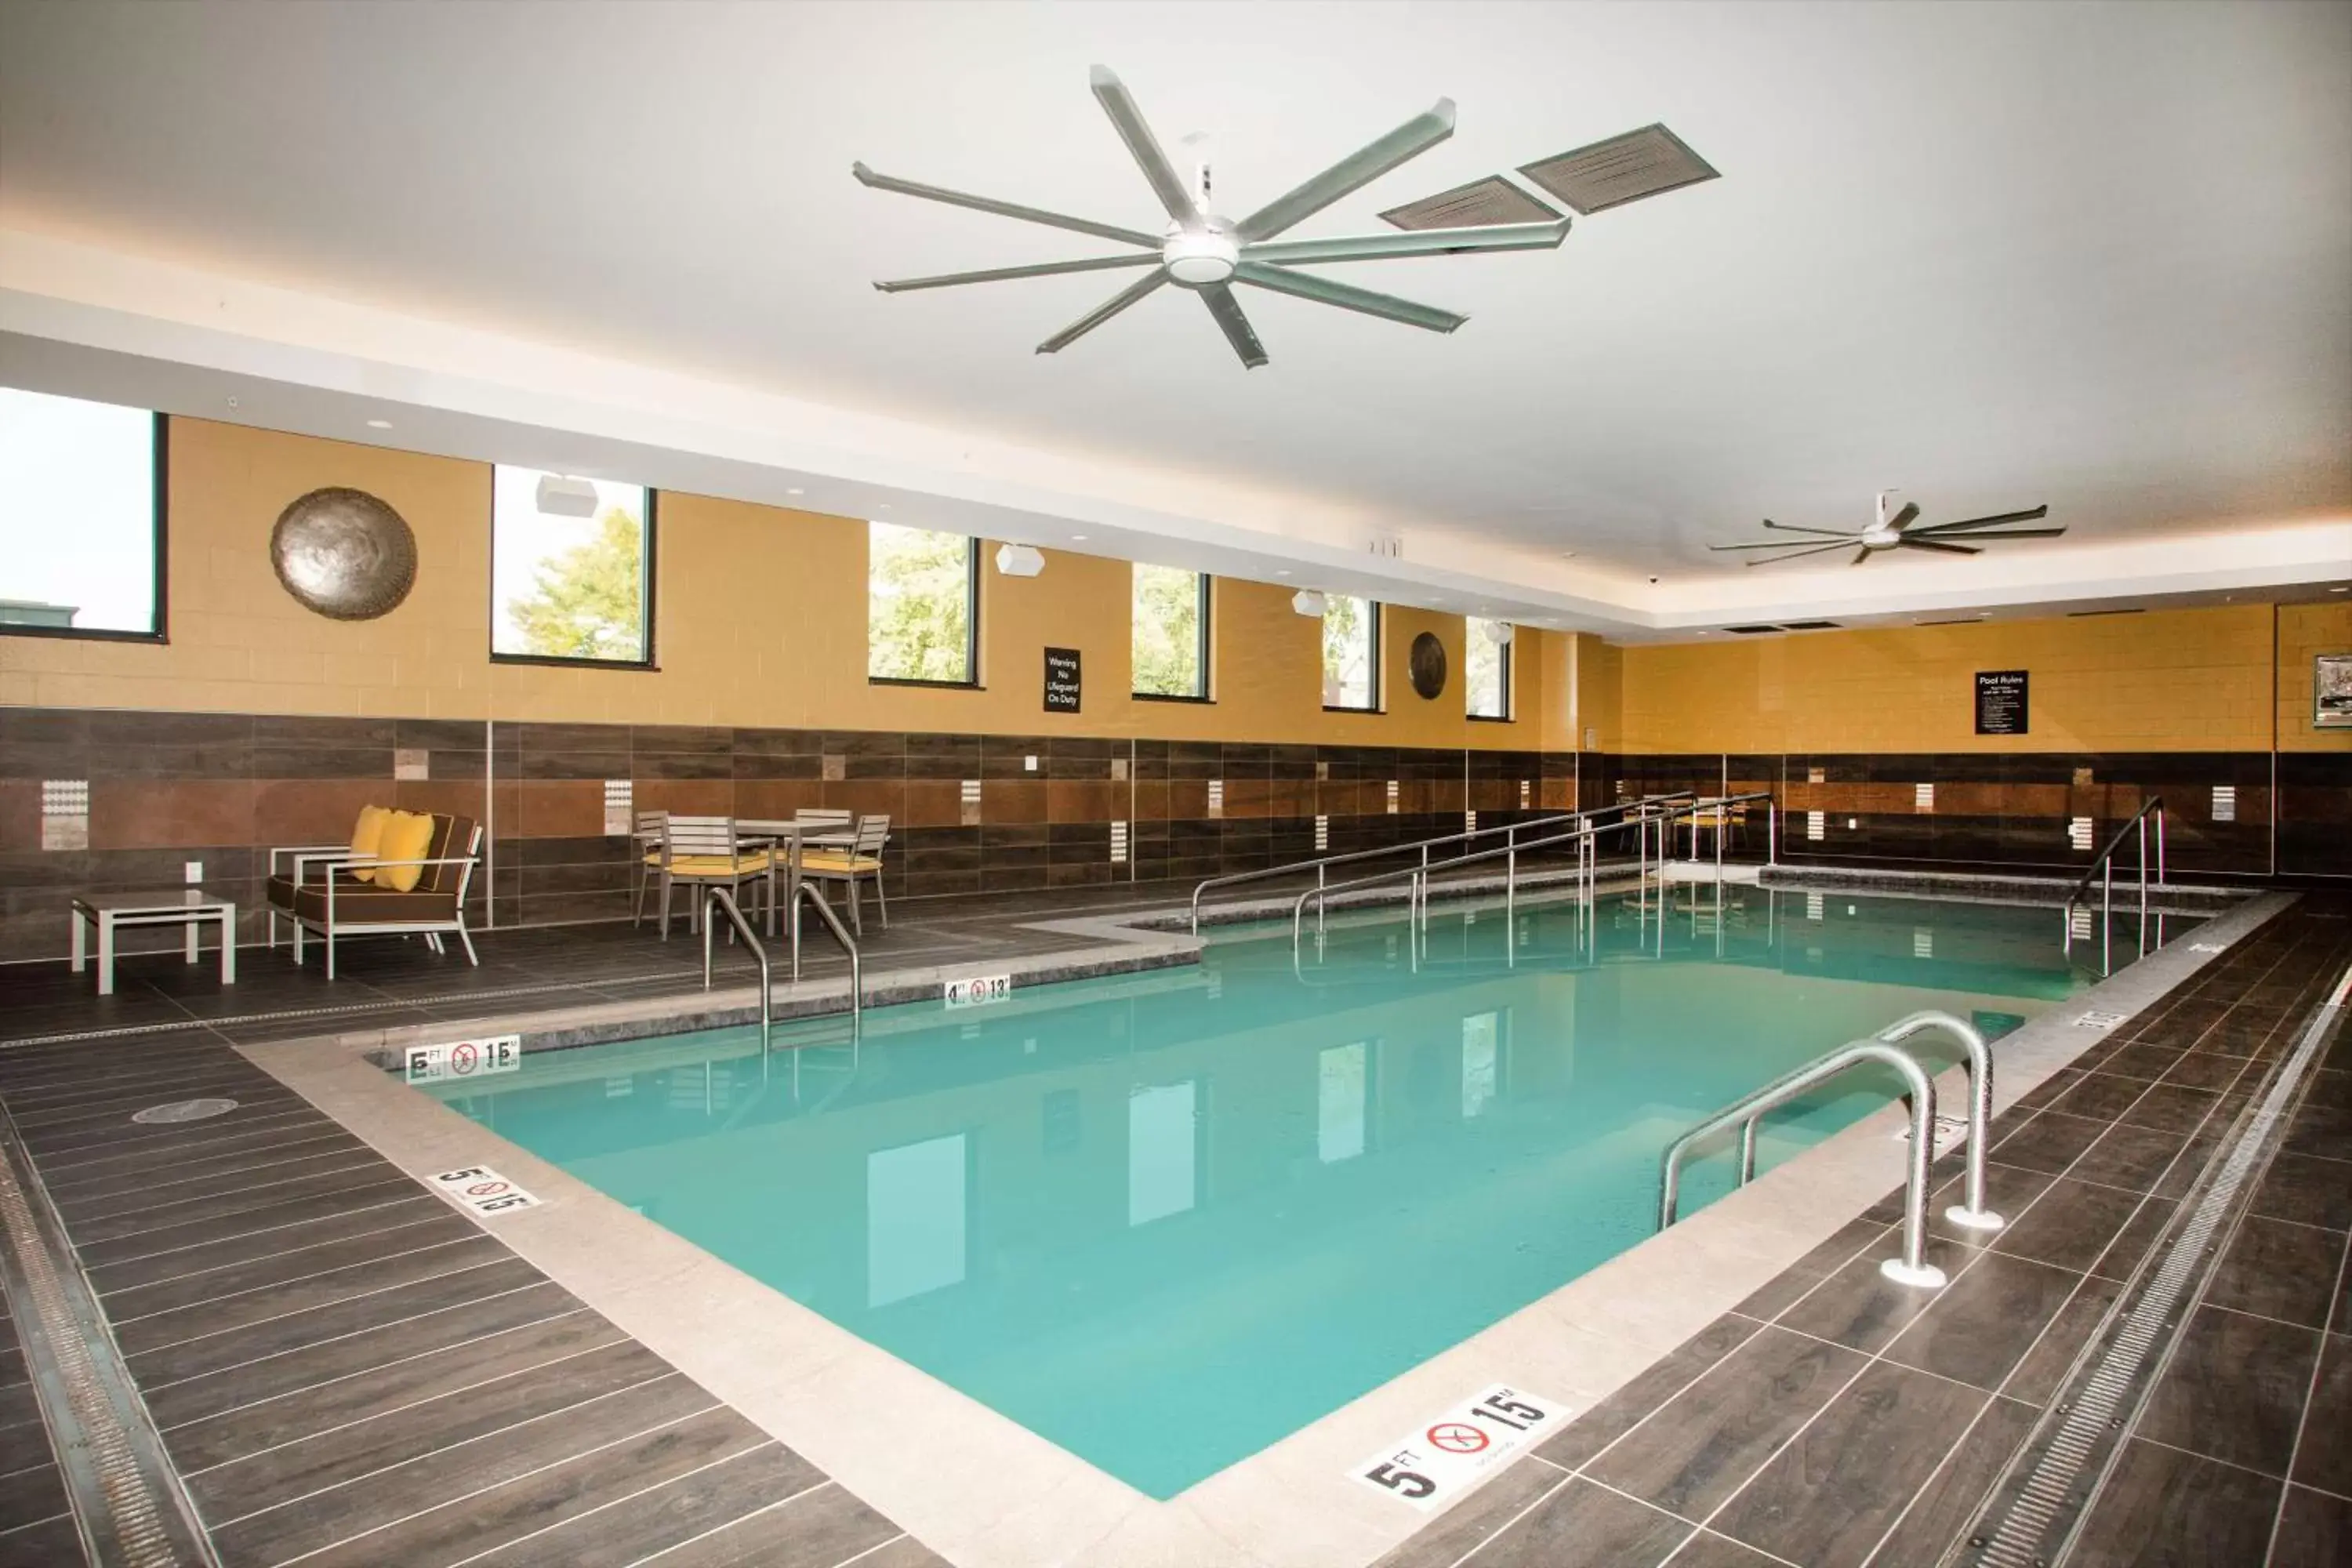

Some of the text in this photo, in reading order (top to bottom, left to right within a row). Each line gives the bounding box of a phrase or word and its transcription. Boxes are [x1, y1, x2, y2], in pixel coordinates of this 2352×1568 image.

[1048, 656, 1076, 670] Warning
[1058, 670, 1069, 680] No
[1980, 675, 2024, 685] Pool Rules
[1047, 681, 1080, 693] Lifeguard
[1048, 694, 1077, 706] On Duty
[439, 1168, 483, 1181] 5
[1392, 1449, 1422, 1467] FT
[1365, 1462, 1436, 1498] 5
